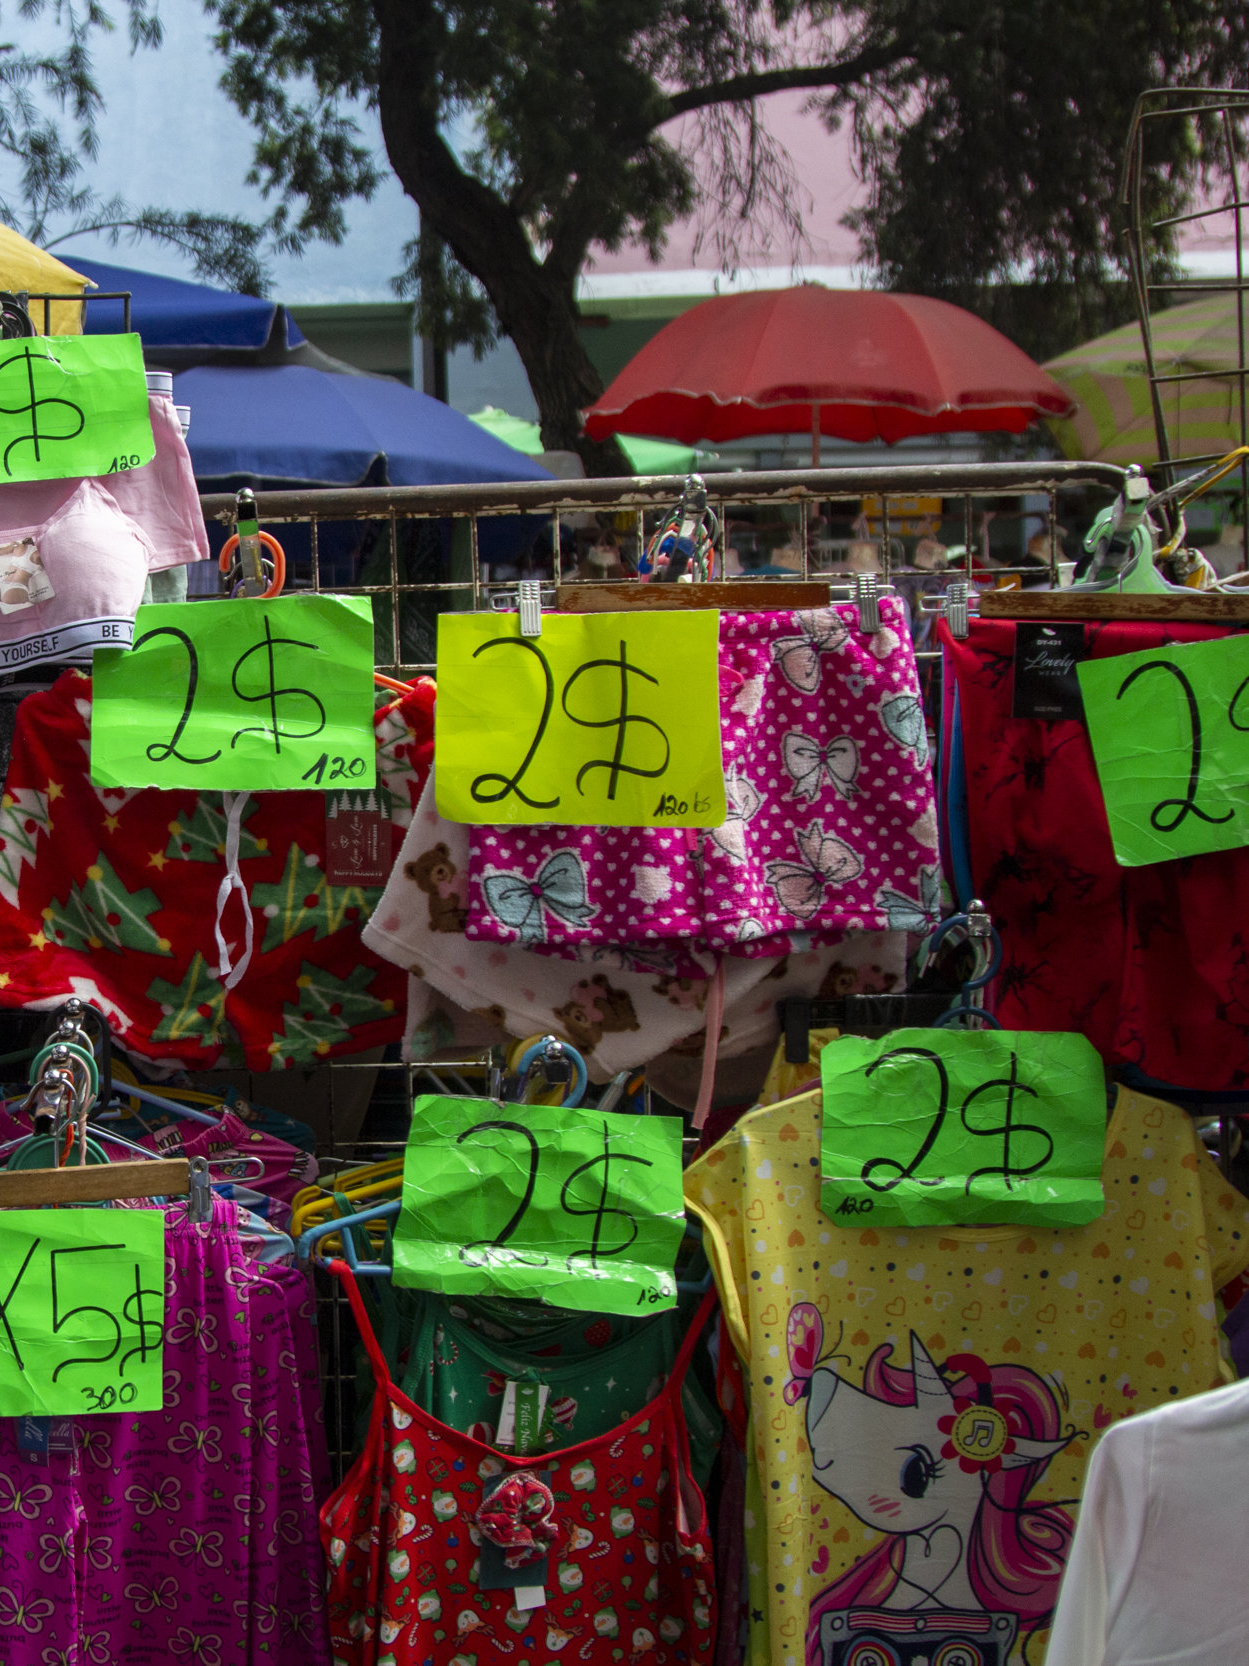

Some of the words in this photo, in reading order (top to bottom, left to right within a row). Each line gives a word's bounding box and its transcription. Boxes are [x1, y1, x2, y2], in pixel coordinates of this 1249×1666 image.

[107, 454, 141, 474] 120
[1, 636, 60, 664] YOURSELF
[102, 624, 120, 638] BE
[1023, 650, 1075, 676] Lovely
[132, 615, 326, 765] 2$
[470, 636, 671, 809] 2$
[301, 752, 367, 785] 120
[653, 793, 689, 816] 120
[861, 1047, 1054, 1196] 2$
[457, 1119, 654, 1281] 2$
[835, 1197, 875, 1216] 120
[636, 1285, 671, 1306] 120
[80, 1381, 138, 1412] 300
[30, 1452, 38, 1462] S
